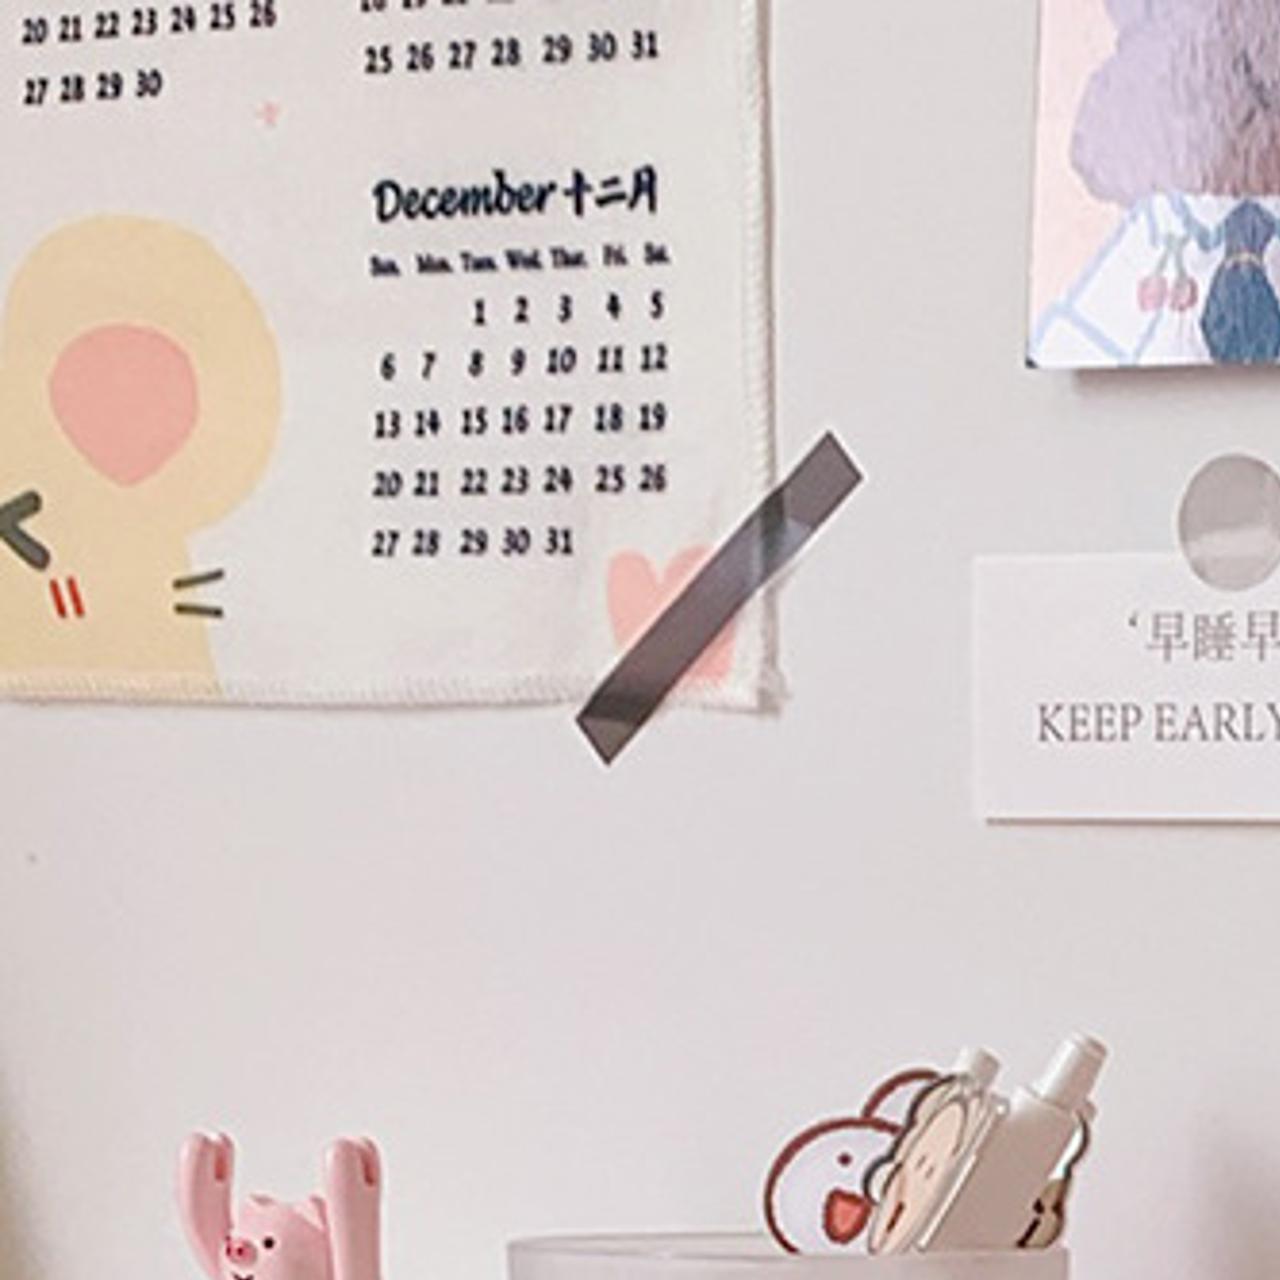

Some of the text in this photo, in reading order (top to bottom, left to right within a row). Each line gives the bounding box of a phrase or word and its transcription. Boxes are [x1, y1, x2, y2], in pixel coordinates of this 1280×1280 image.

[21, 0, 277, 45] 20 21 22 23 24 25 26
[365, 30, 658, 74] 25 26 27 28 29 30 31
[24, 69, 163, 105] 27 28 29 30
[372, 164, 657, 224] December 十二月
[474, 290, 664, 327] 1 2 3 4 5
[380, 343, 667, 381] 6 7 8 9 10 11 12
[375, 402, 666, 439] 13 14 15 16 17 18 19
[372, 464, 667, 498] 20 21 22 23 24 25 26
[372, 527, 573, 557] 27 28 29 30 31
[1038, 703, 1143, 743] KEEP
